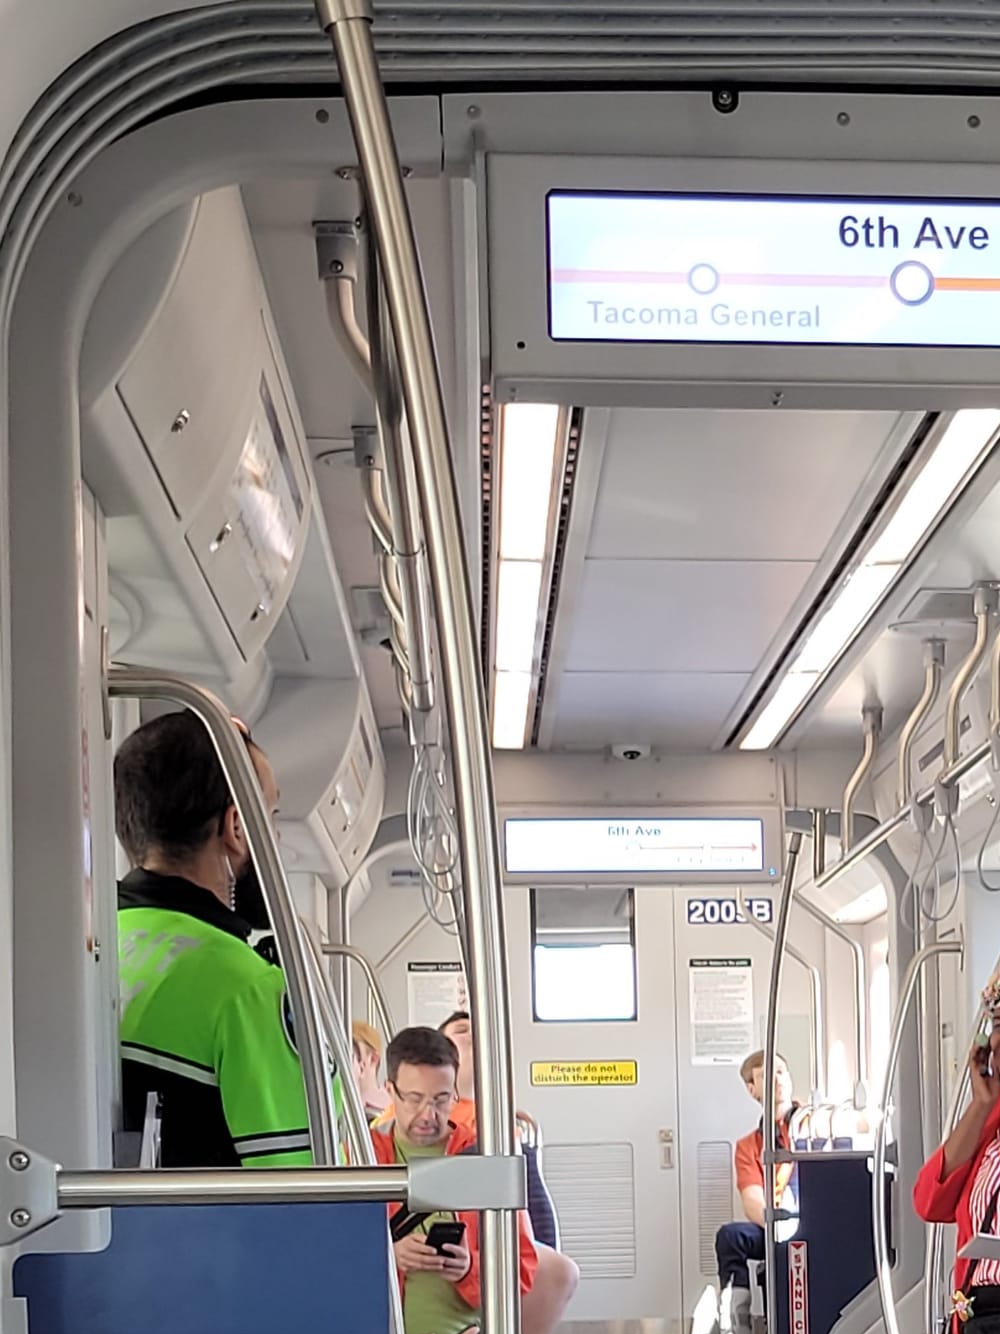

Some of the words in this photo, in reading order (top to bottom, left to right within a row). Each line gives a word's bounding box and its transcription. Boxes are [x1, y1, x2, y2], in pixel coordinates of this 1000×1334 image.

[838, 215, 899, 249] 6th
[913, 216, 990, 250] Ave
[587, 301, 698, 324] Tacoma
[710, 303, 820, 327] General
[534, 1074, 570, 1082] disturb
[572, 1074, 588, 1082] the
[591, 1073, 633, 1084] operator
[551, 1064, 582, 1073] Please
[584, 1064, 597, 1073] do
[600, 1064, 617, 1073] not
[794, 1253, 803, 1310] STAND
